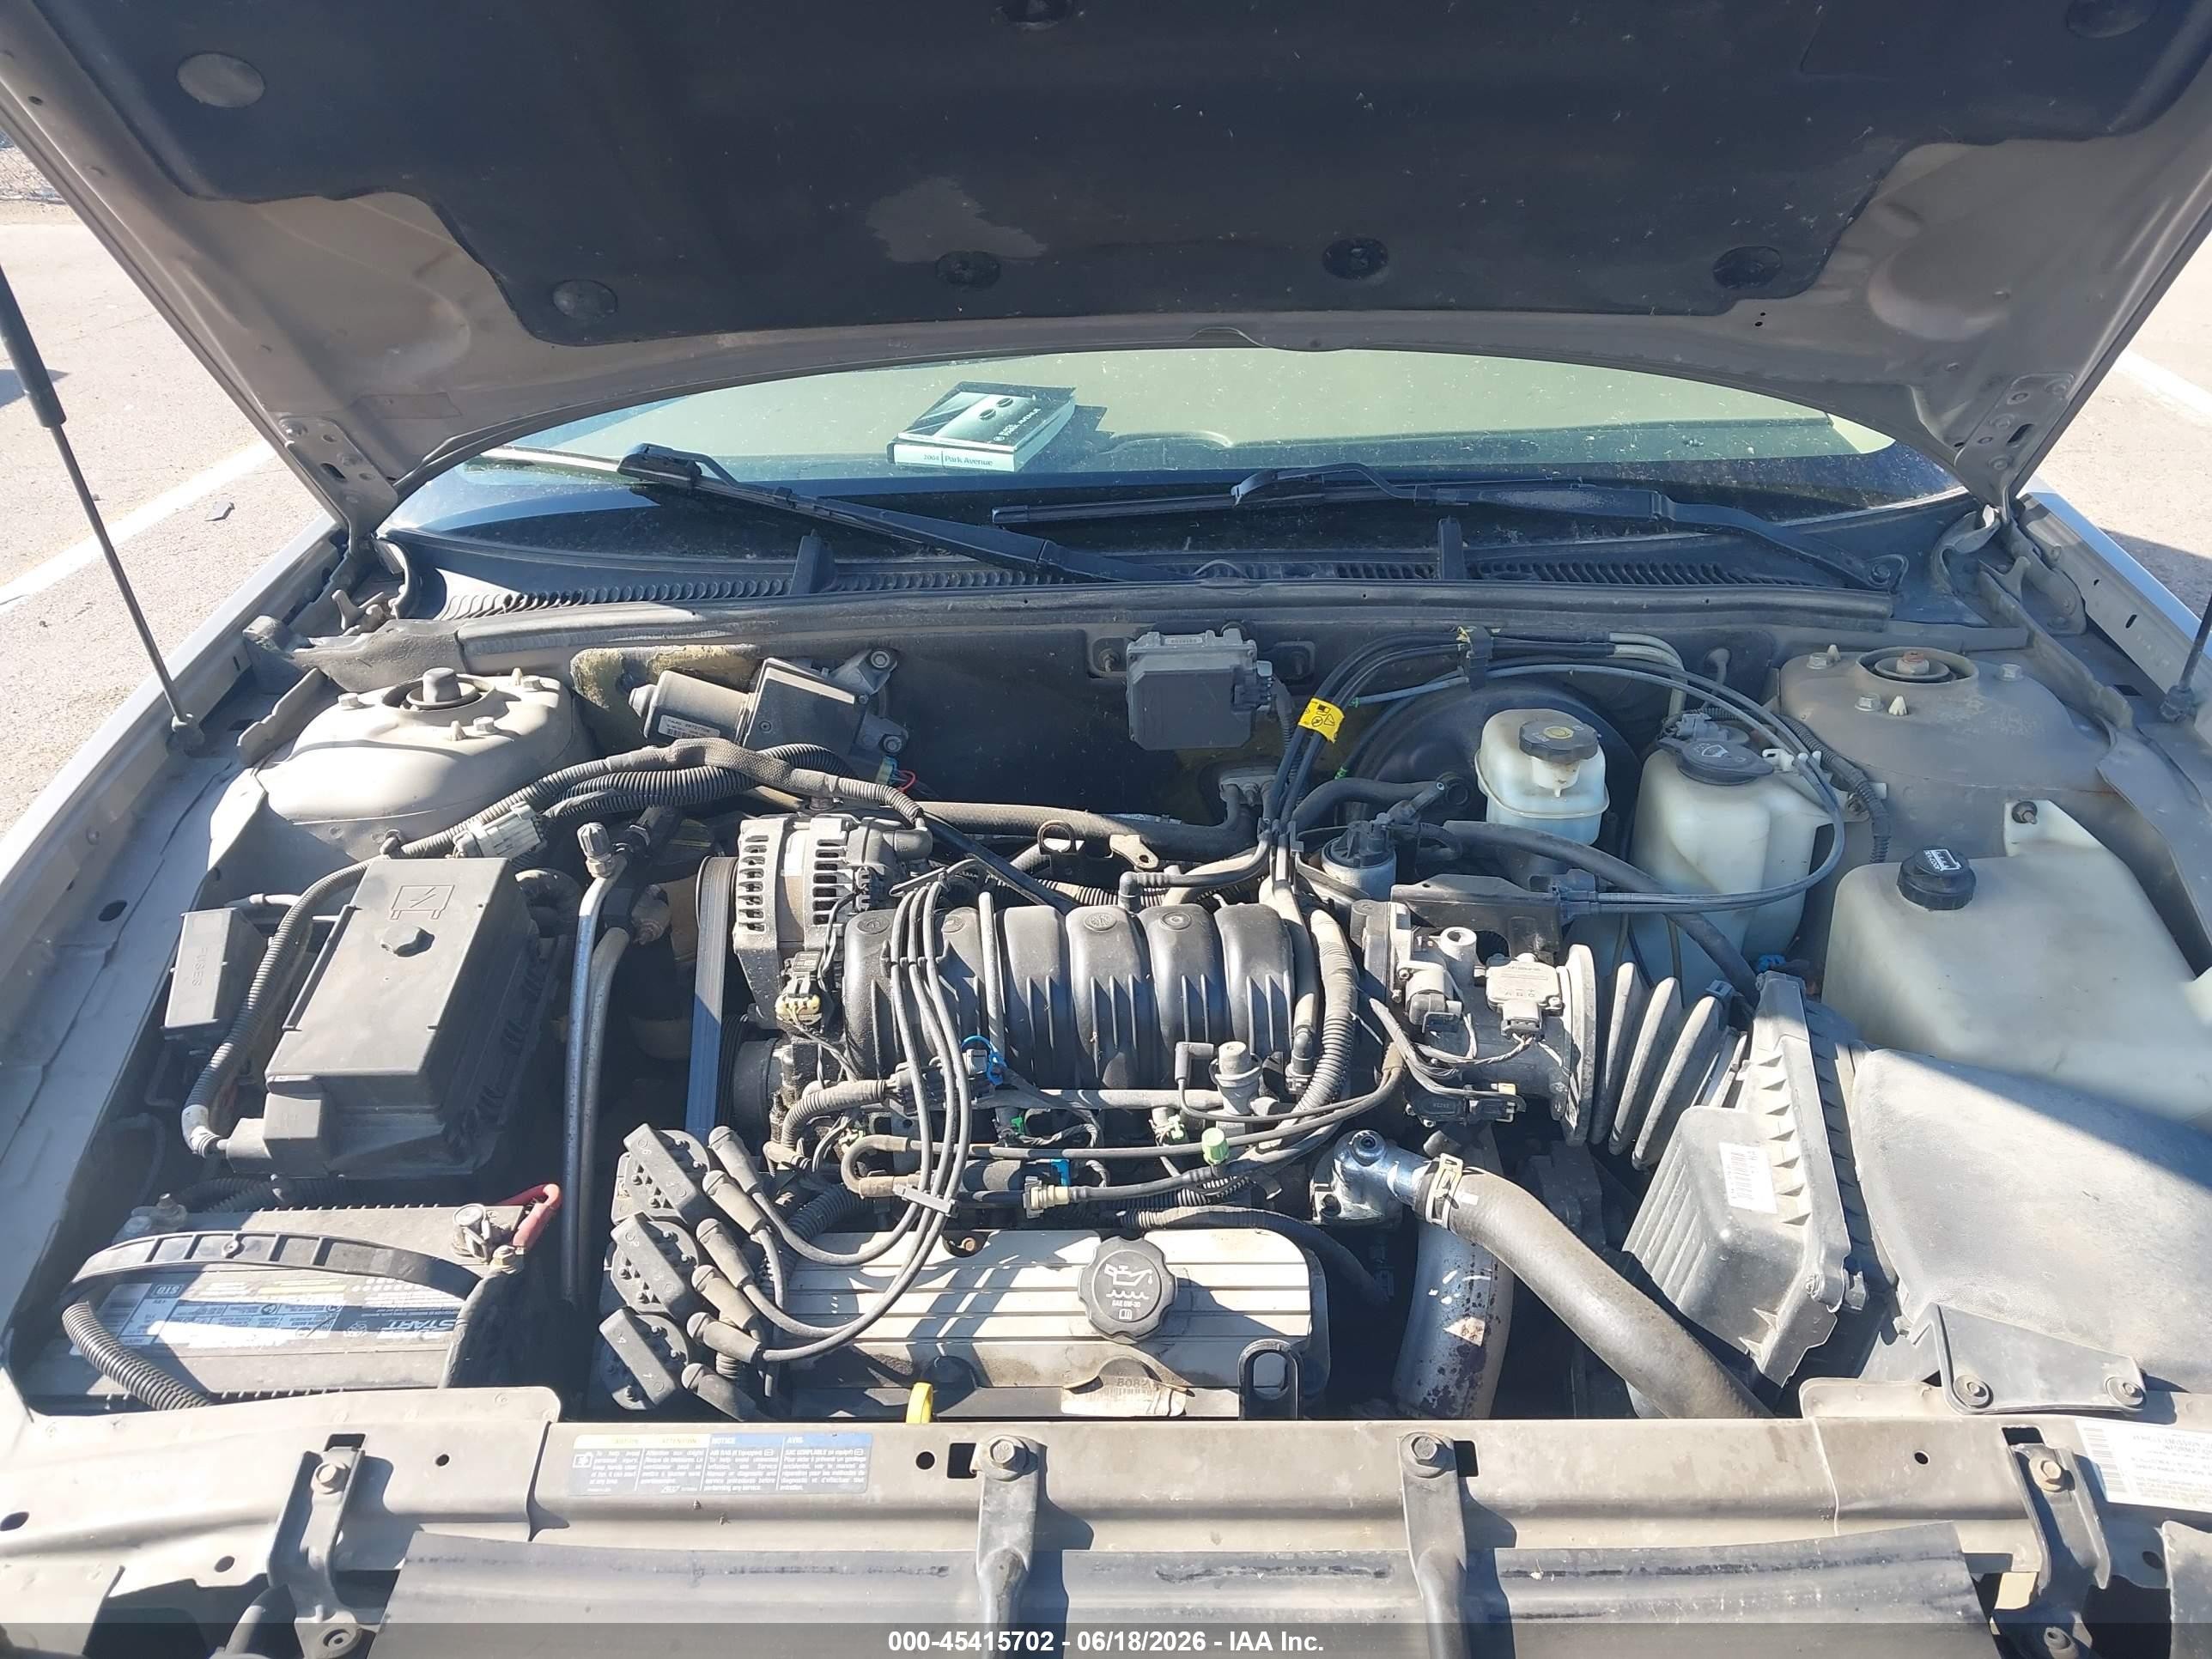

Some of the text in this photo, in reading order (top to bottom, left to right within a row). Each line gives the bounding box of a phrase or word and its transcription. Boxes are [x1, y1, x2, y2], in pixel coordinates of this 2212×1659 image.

[945, 455, 963, 464] Park
[963, 457, 993, 466] Avenue
[191, 947, 209, 987] FUSES
[381, 1319, 456, 1330] START
